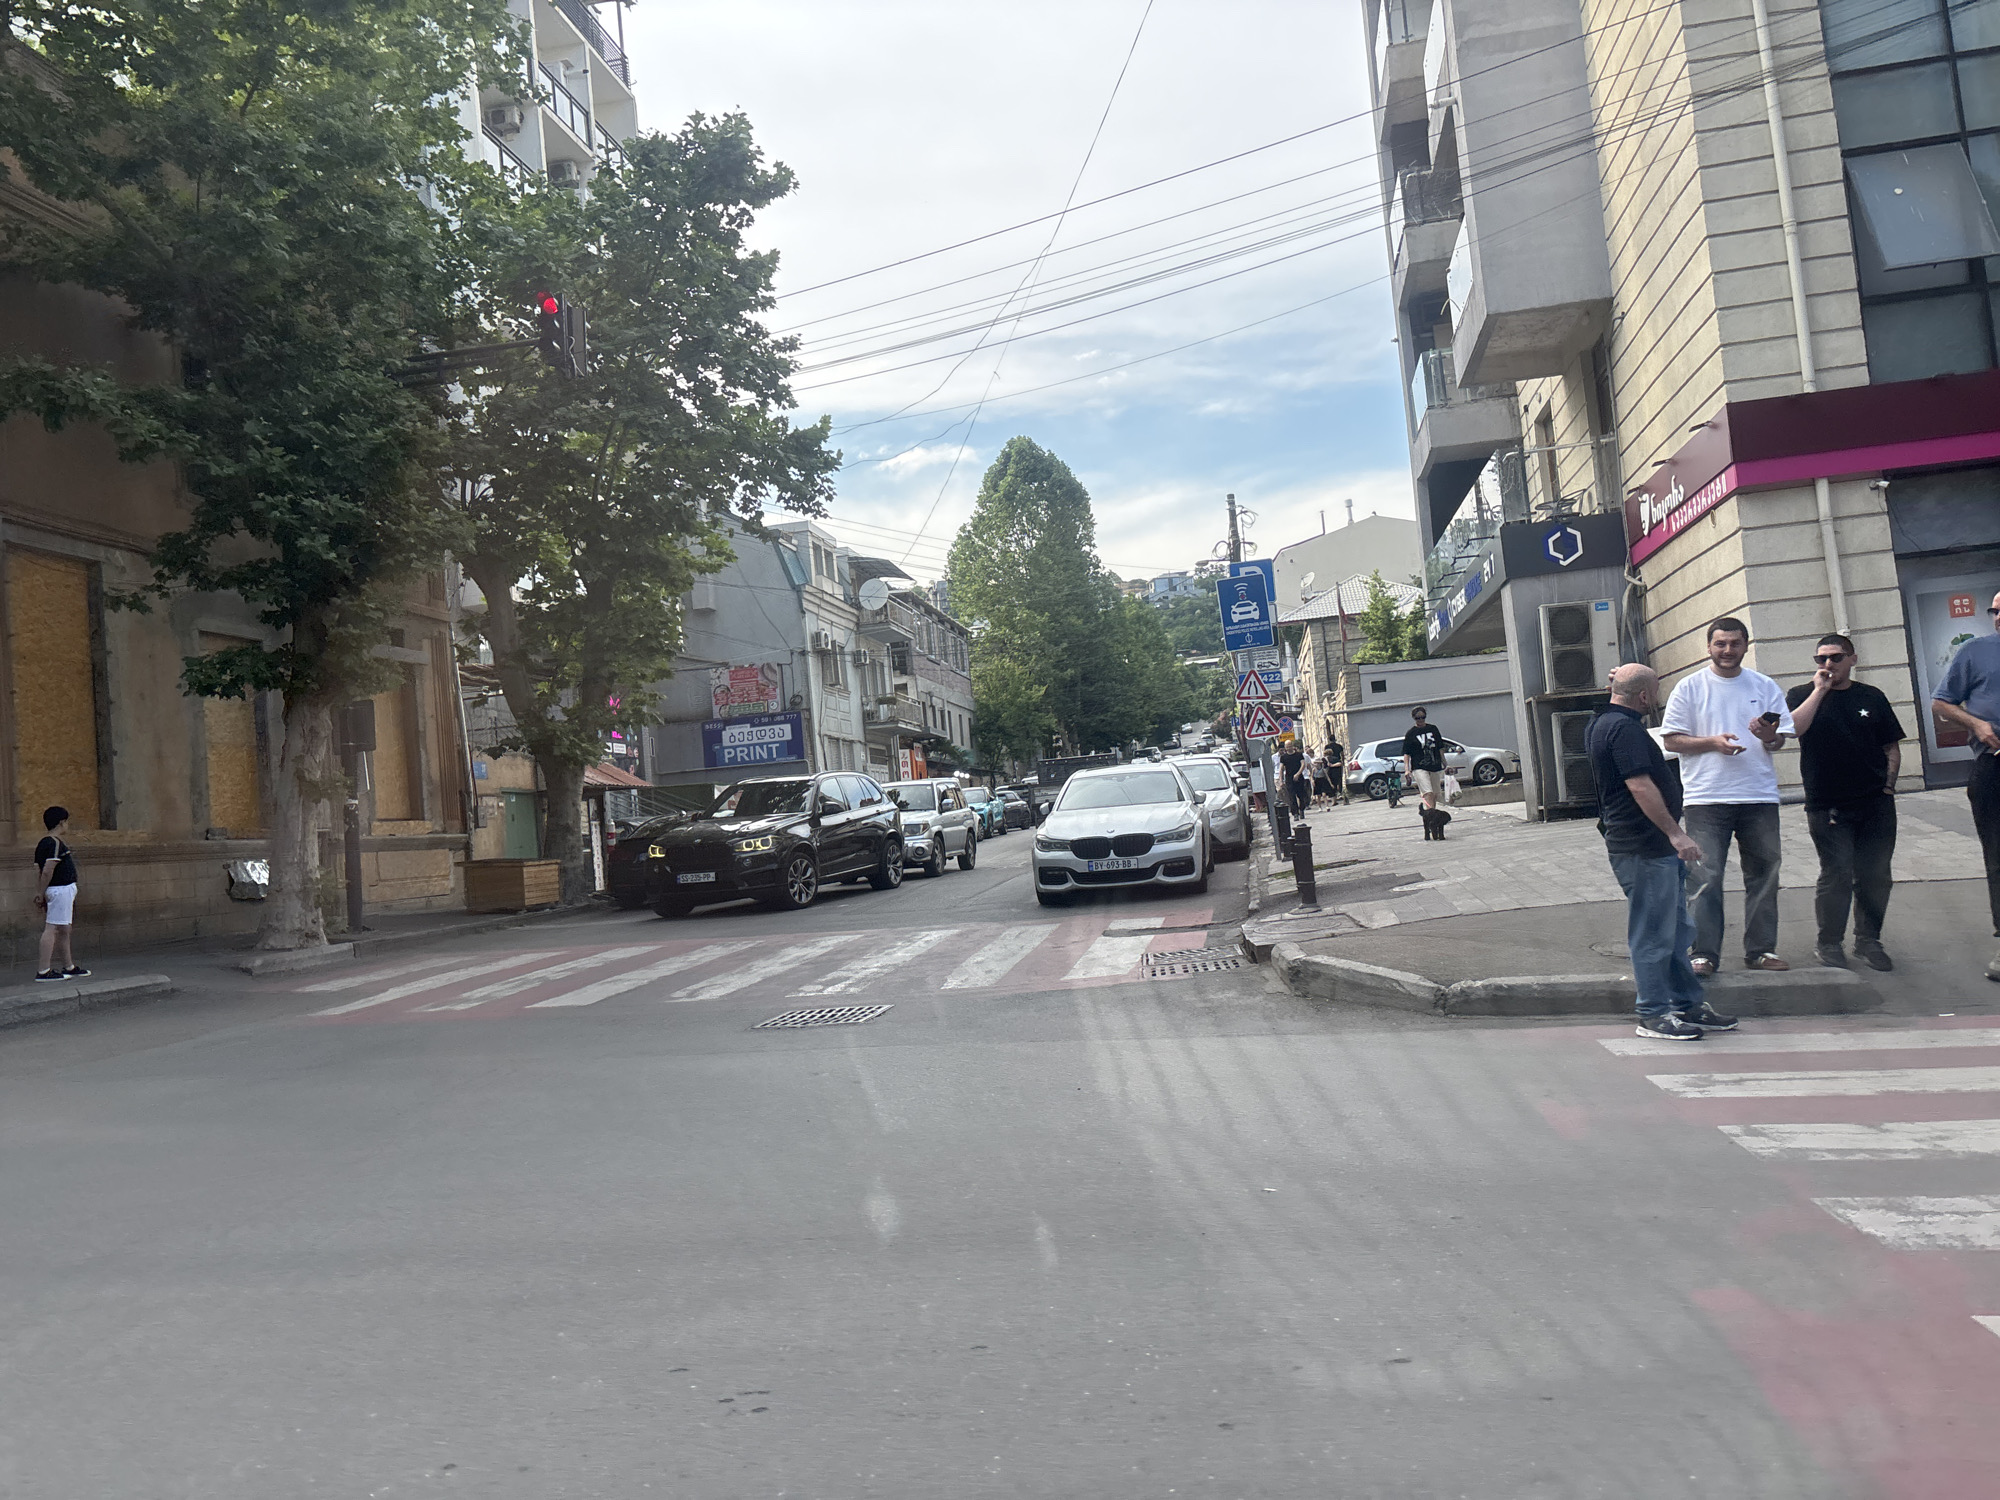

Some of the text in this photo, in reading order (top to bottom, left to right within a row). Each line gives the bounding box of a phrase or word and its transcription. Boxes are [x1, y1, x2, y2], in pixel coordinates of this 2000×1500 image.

[1259, 673, 1281, 682] 422
[729, 727, 785, 743] ბეჭდვა
[723, 743, 779, 764] PRINT
[1094, 860, 1132, 870] BY-693-BB
[681, 873, 711, 882] SS-235-PP
